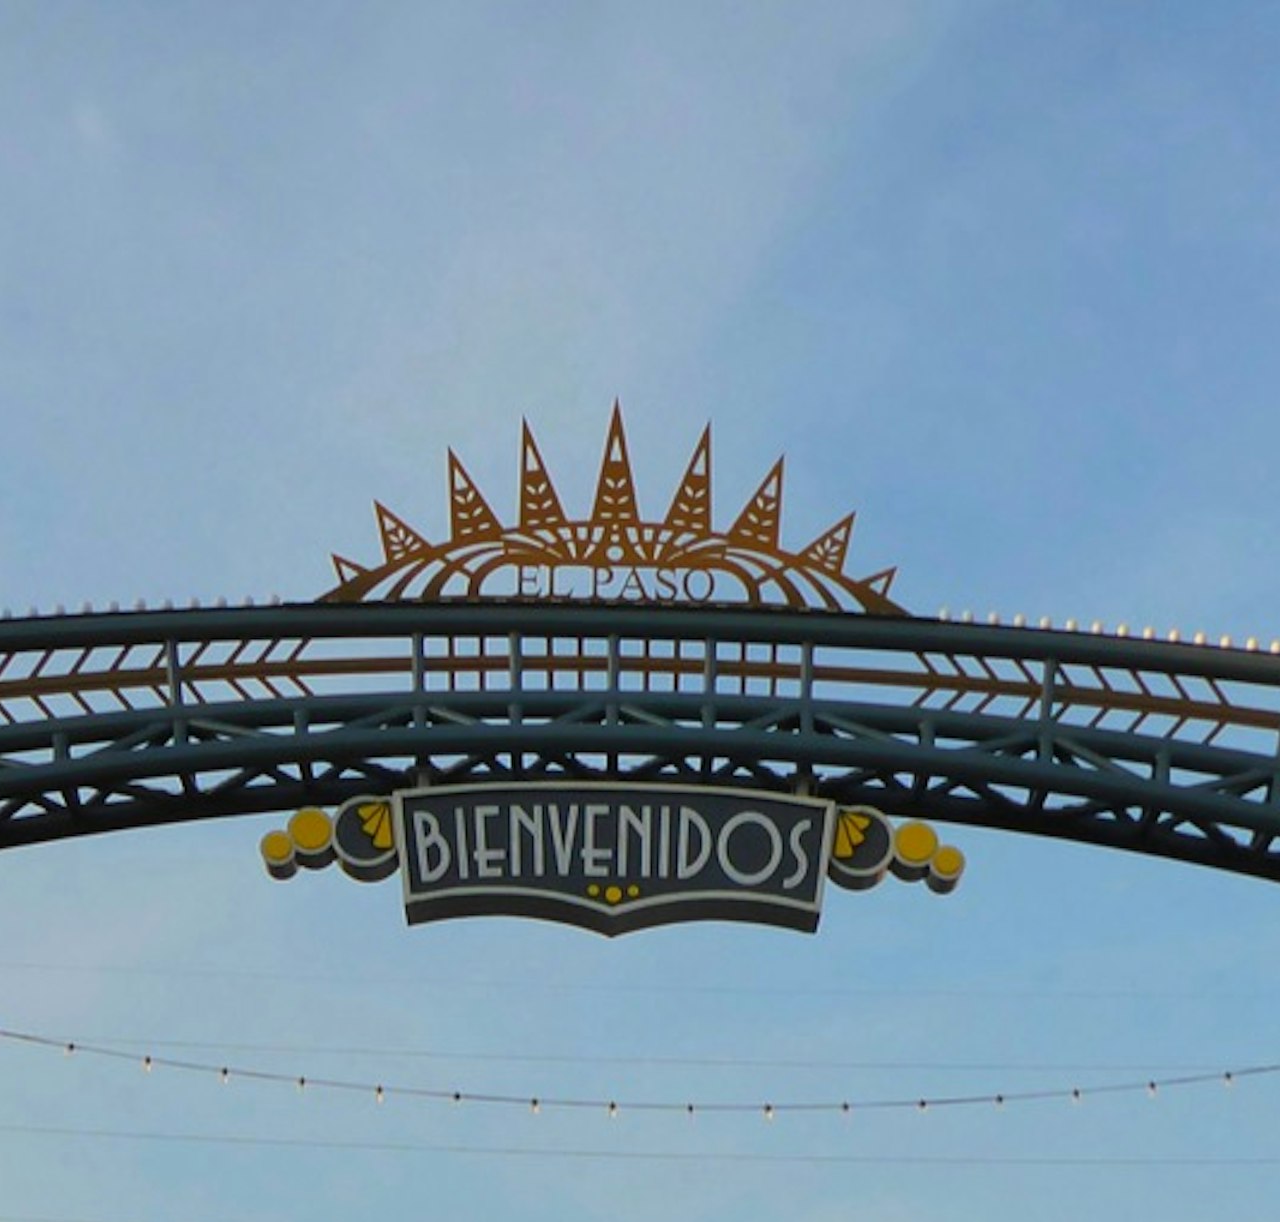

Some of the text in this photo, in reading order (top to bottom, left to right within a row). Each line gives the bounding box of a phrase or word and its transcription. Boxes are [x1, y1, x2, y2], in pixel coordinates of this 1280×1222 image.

[518, 564, 716, 602] EL PASO
[413, 804, 813, 890] BIENVENIDOS
